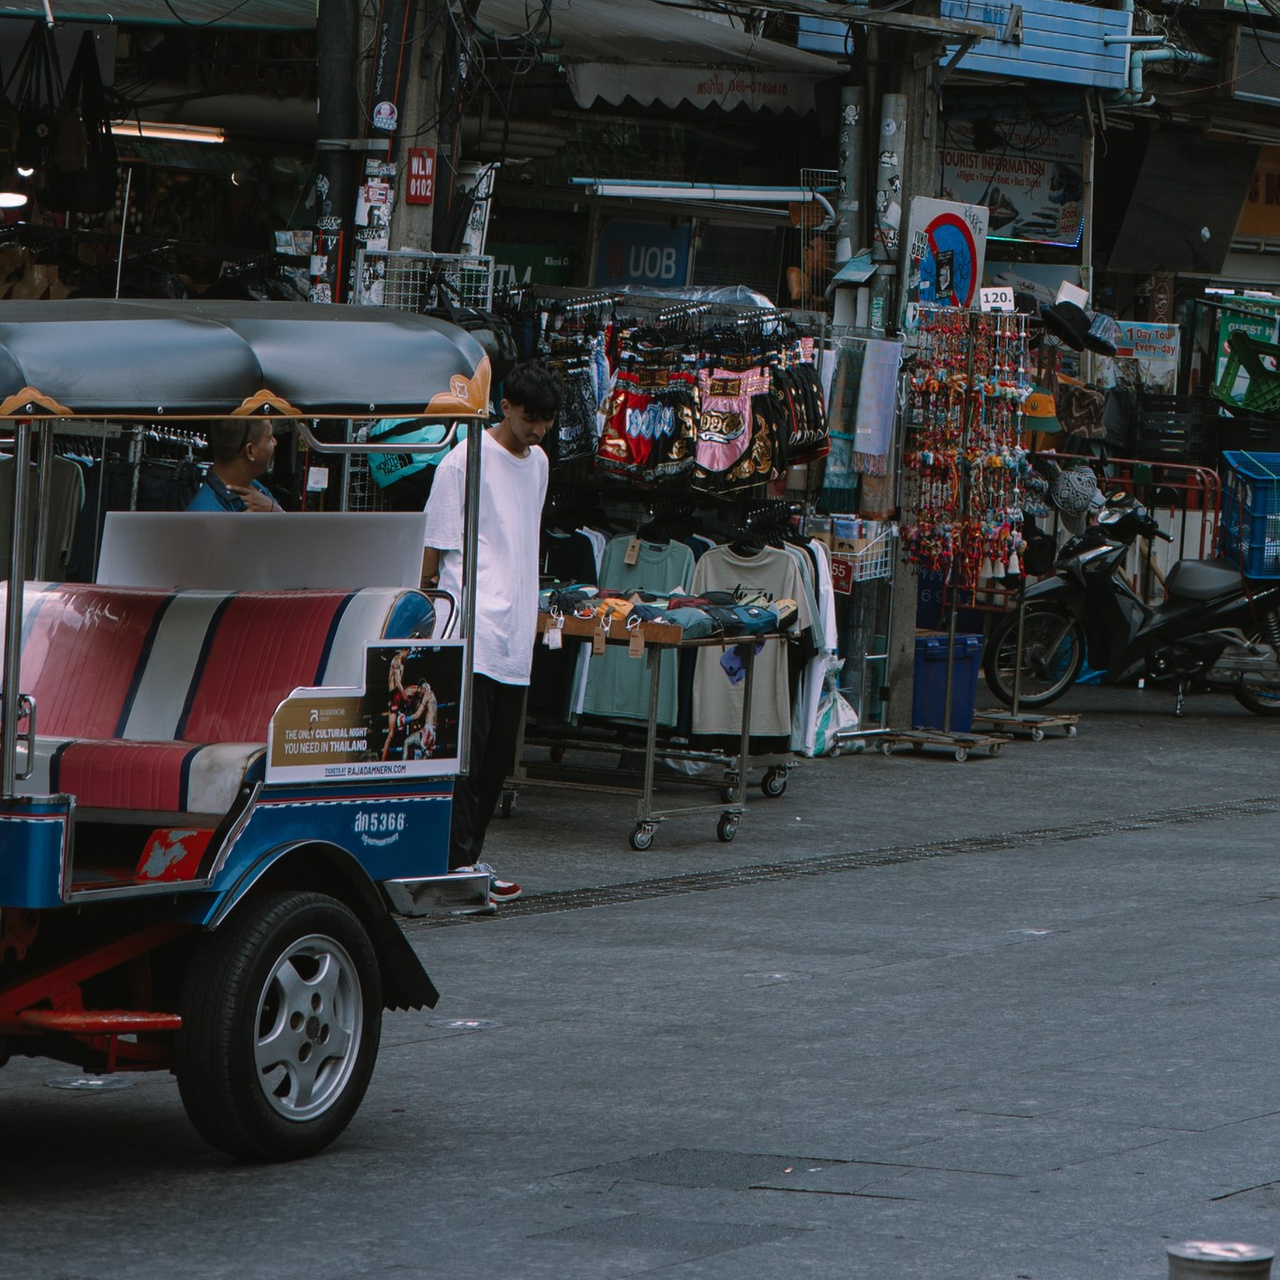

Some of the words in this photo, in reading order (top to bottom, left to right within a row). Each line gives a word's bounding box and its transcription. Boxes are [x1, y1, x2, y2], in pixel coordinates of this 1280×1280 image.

[411, 156, 434, 176] WLW
[938, 150, 980, 169] TOURIST
[982, 157, 1046, 177] INFORMATION
[959, 171, 975, 184] Flight
[1014, 177, 1025, 187] Bus
[410, 178, 432, 198] 0102
[1061, 207, 1078, 220] Book
[629, 245, 677, 280] UOB
[983, 291, 1012, 304] 120.
[1126, 328, 1134, 340] 1
[1137, 329, 1154, 341] Day
[1155, 329, 1174, 340] Tour
[1135, 342, 1176, 356] Every-day
[285, 729, 298, 740] THE
[298, 729, 315, 740] ONLY
[315, 727, 349, 739] CULTURAL
[349, 727, 368, 737] NIGHT
[284, 743, 299, 755] YOU
[300, 742, 320, 753] NEED
[321, 742, 329, 753] IN
[330, 740, 368, 752] THAILAND
[347, 765, 406, 777] RAJADAMNERN.COM
